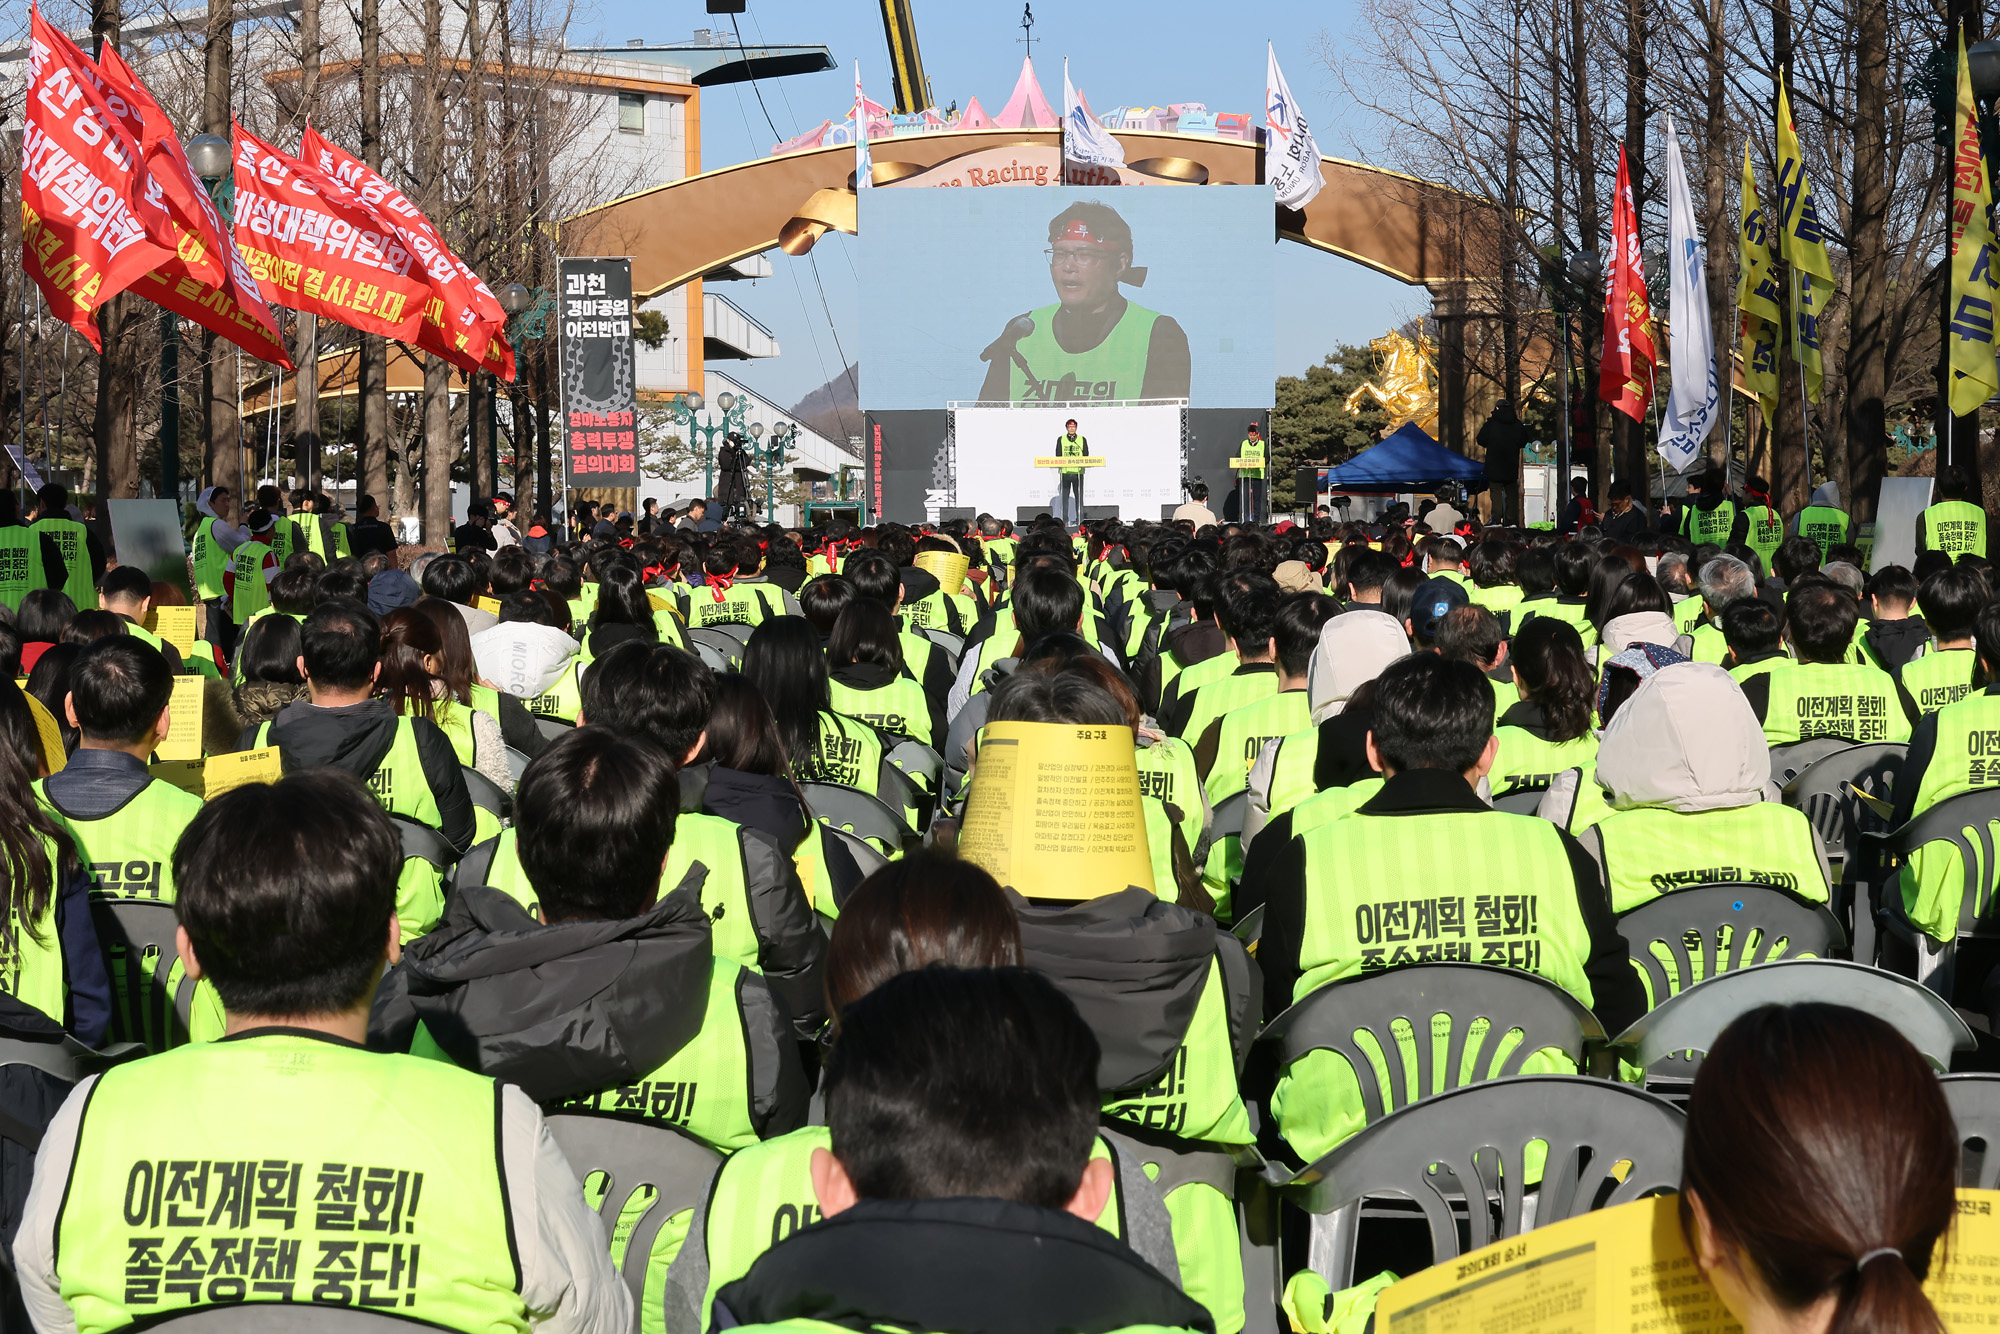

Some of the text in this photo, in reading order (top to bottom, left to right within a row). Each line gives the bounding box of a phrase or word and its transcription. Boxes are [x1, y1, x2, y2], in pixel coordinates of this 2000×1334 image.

[967, 159, 1048, 187] Racing
[233, 186, 414, 277] 비상대책위원회
[566, 273, 606, 295] 과천
[566, 299, 629, 317] 경마공원
[566, 320, 630, 338] 이전반대
[568, 411, 634, 427] 경마노동자
[570, 431, 635, 450] 총력투쟁
[571, 453, 636, 474] 결의대회
[1937, 521, 1979, 532] 이전계획 철회!
[1938, 531, 1978, 542] 졸속정책 중단!
[12, 559, 29, 570] 중단!
[12, 570, 29, 581] 사수!
[700, 601, 749, 617] 이전계획 철회!
[1796, 695, 1886, 718] 이전계획 철회!
[1076, 730, 1107, 740] 주요 구호
[1859, 719, 1887, 740] 중단!
[1355, 895, 1537, 944] 이전계획 철회!
[124, 1158, 424, 1234] 이전계획 철회!
[124, 1236, 421, 1308] 졸속정책 중단!
